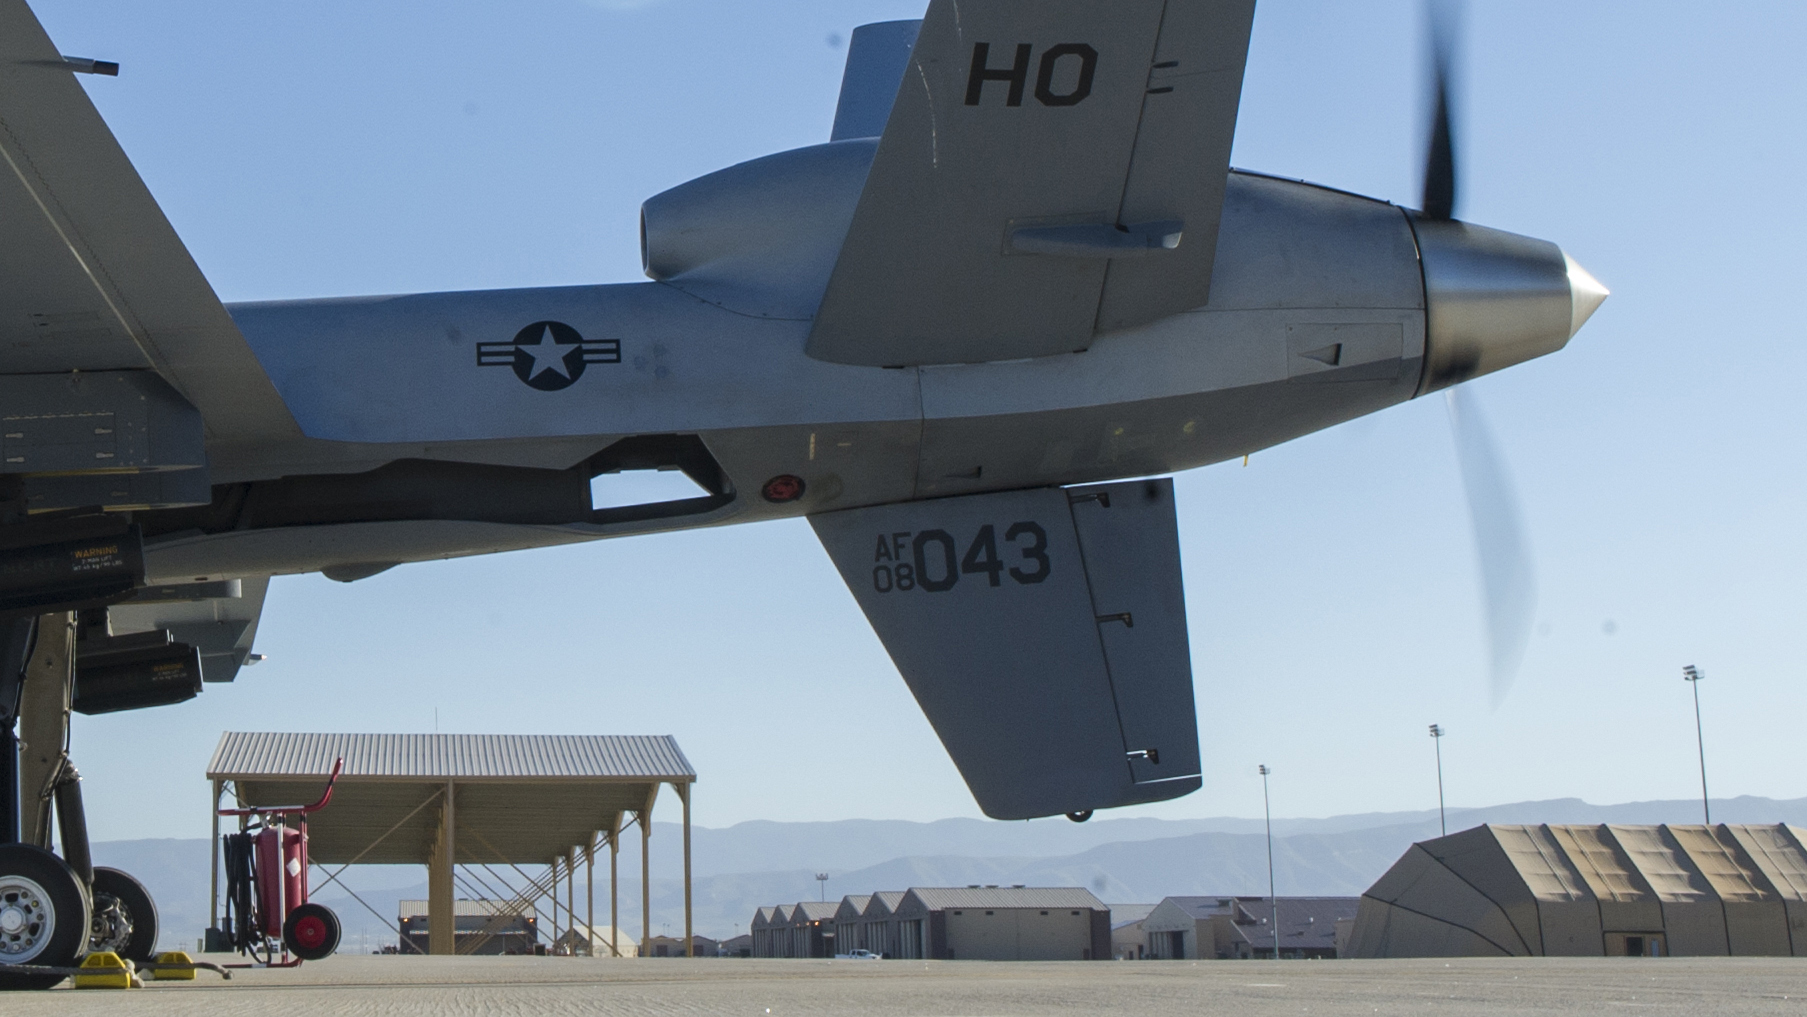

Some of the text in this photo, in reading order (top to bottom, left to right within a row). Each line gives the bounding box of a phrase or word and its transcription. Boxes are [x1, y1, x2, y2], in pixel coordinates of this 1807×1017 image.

[964, 42, 1099, 107] HO
[74, 545, 118, 559] WARNING
[874, 531, 913, 563] AF
[912, 521, 1051, 592] 043
[872, 563, 915, 594] 08
